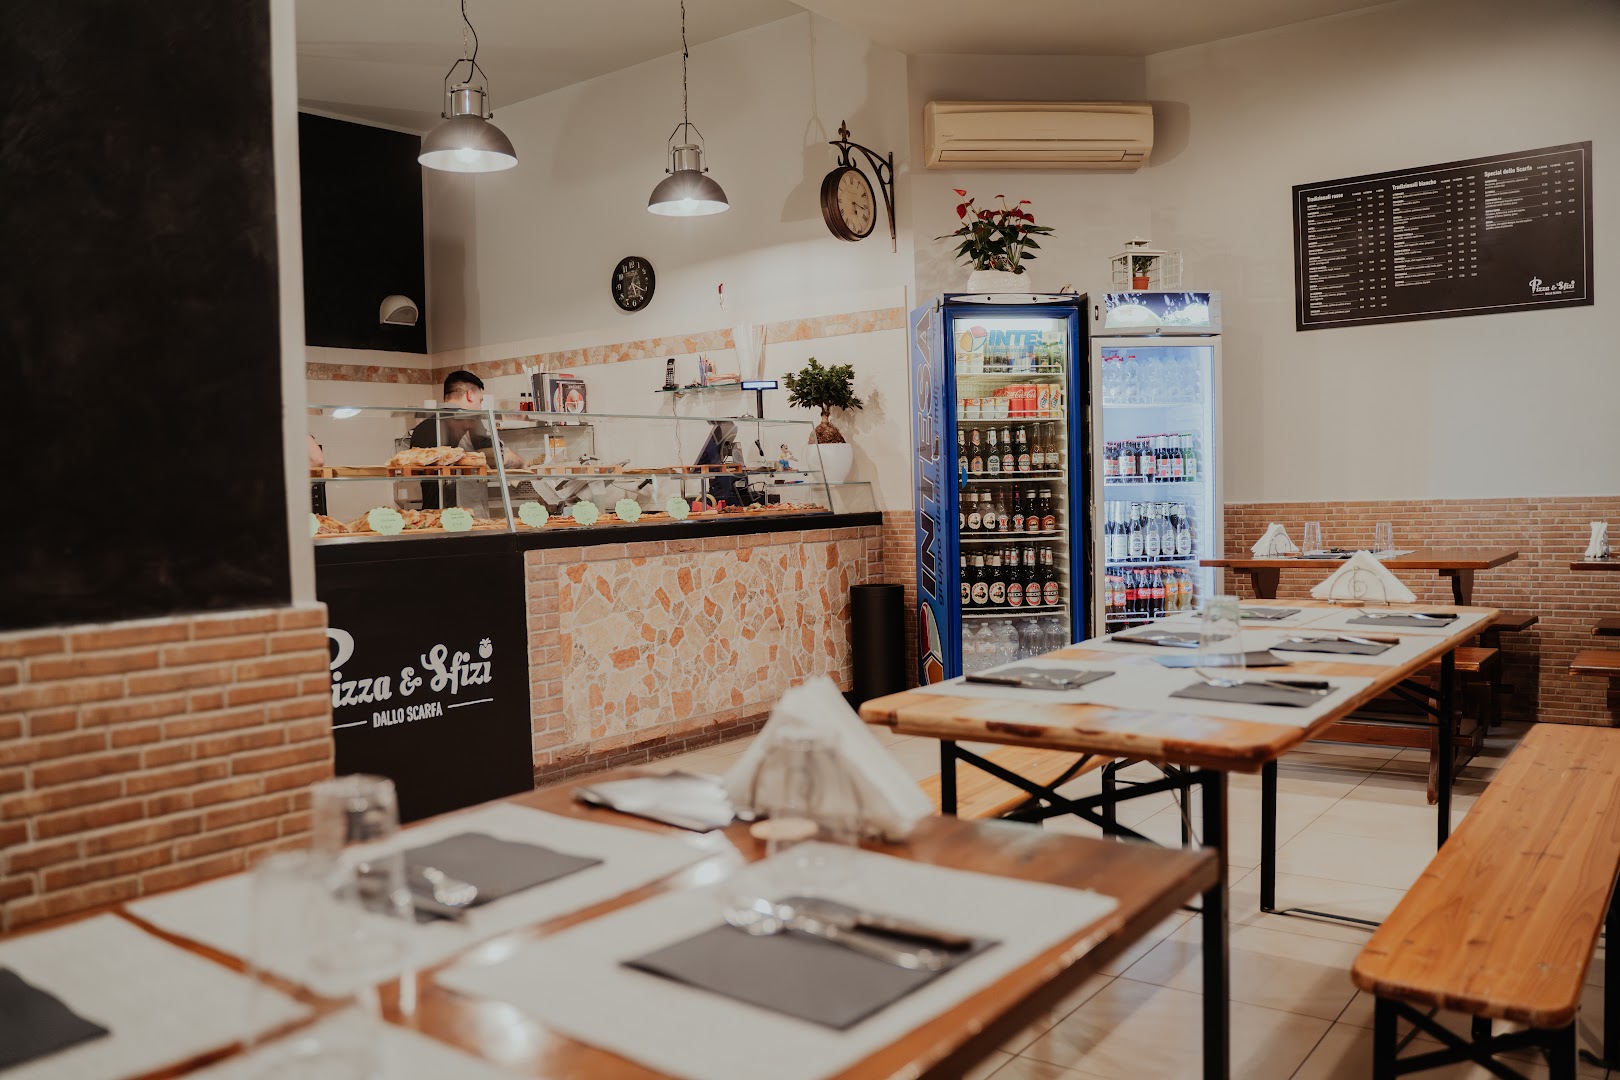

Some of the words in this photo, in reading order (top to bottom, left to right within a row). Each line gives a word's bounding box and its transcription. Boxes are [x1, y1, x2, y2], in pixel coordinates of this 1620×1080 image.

[1484, 169, 1502, 178] Special
[1392, 181, 1418, 190] Tradizionali
[1419, 179, 1437, 187] bianche
[1307, 194, 1331, 203] Tradizionali
[1529, 276, 1550, 294] Pizza
[1556, 280, 1575, 291] Sfizi
[915, 308, 937, 600] INTESA
[399, 666, 423, 697] &
[420, 637, 493, 695] Sfizi
[373, 709, 405, 728] DALLO
[406, 701, 443, 722] SCARFA
